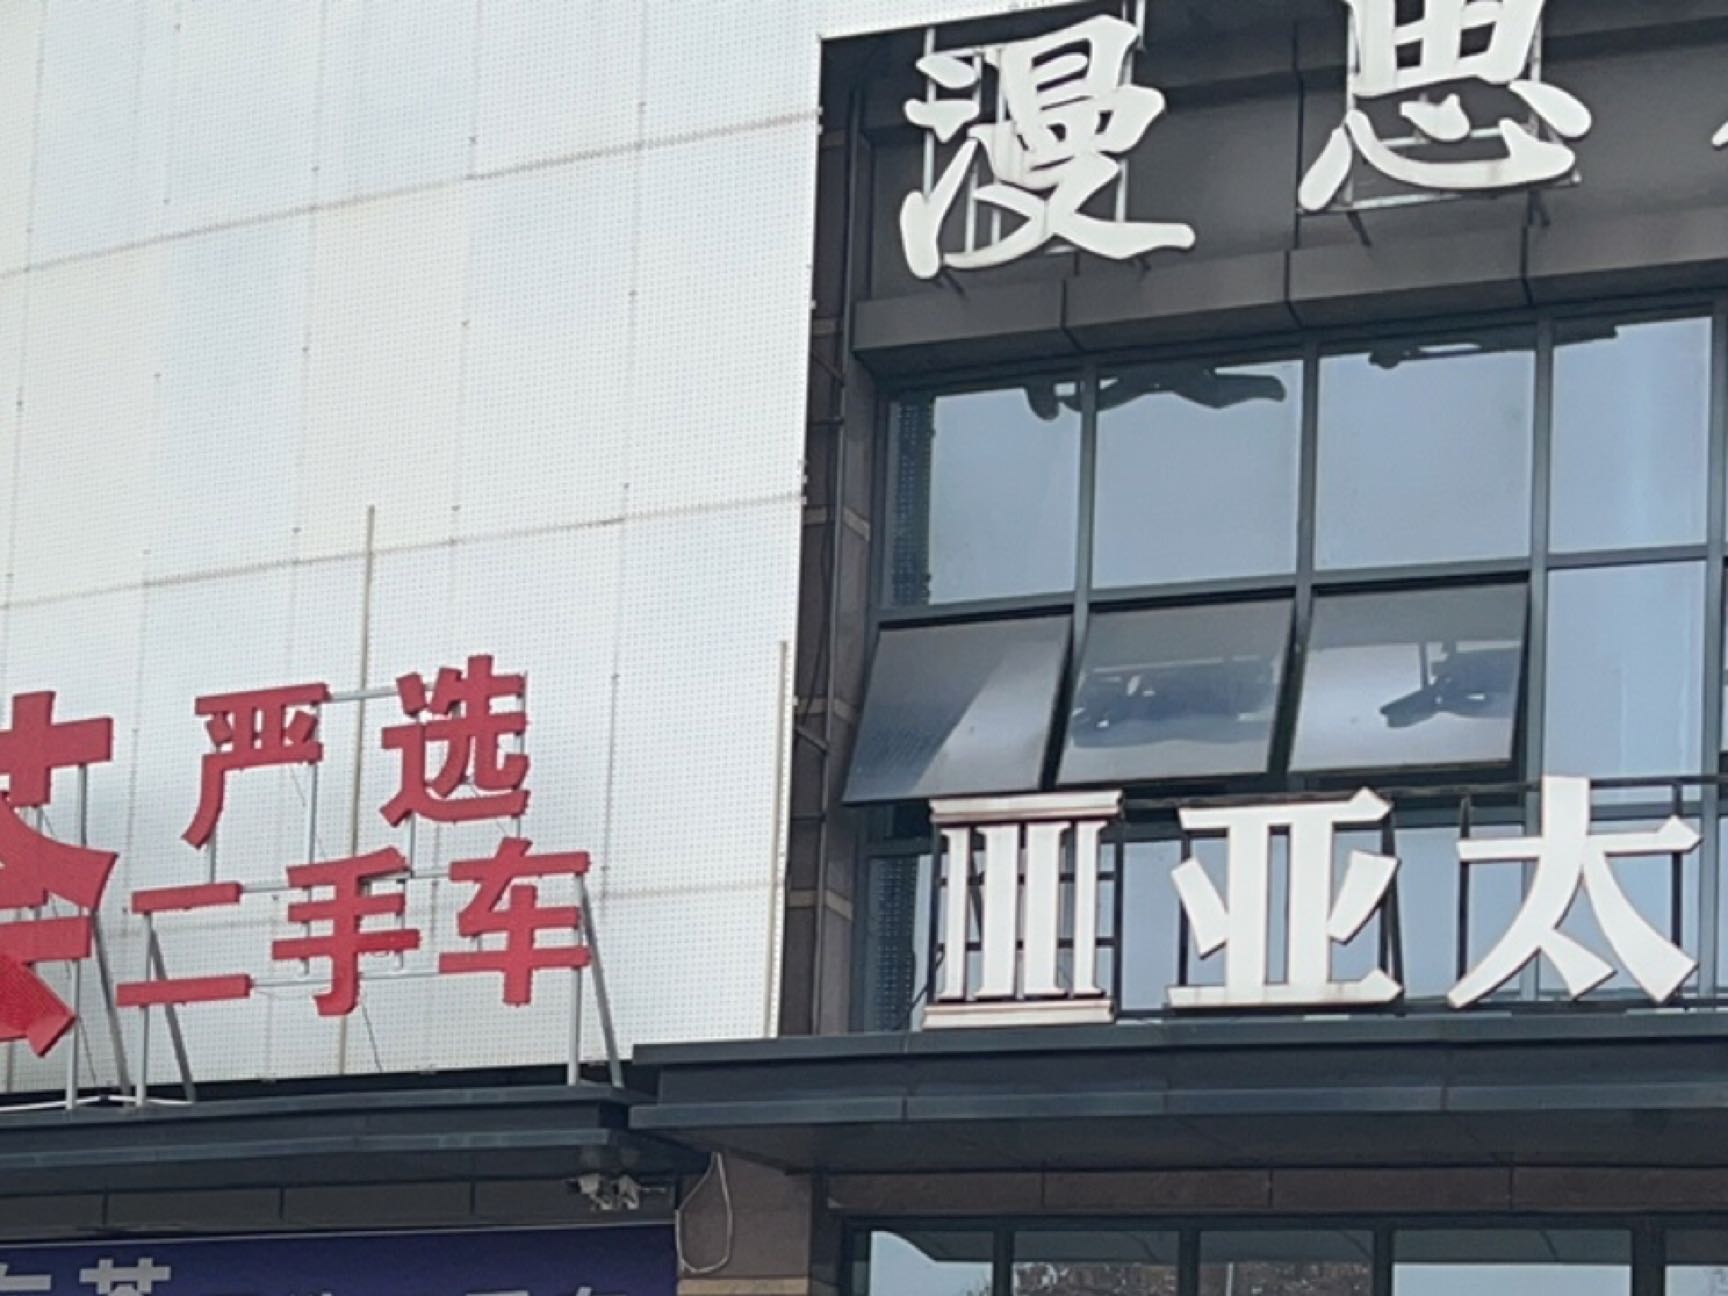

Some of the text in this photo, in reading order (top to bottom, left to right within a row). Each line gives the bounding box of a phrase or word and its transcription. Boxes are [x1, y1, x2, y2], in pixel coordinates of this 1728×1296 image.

[899, 0, 1728, 280] 漫思
[181, 653, 532, 850] 严选
[115, 836, 591, 1018] 二手车
[1165, 774, 1704, 1009] 亚太
